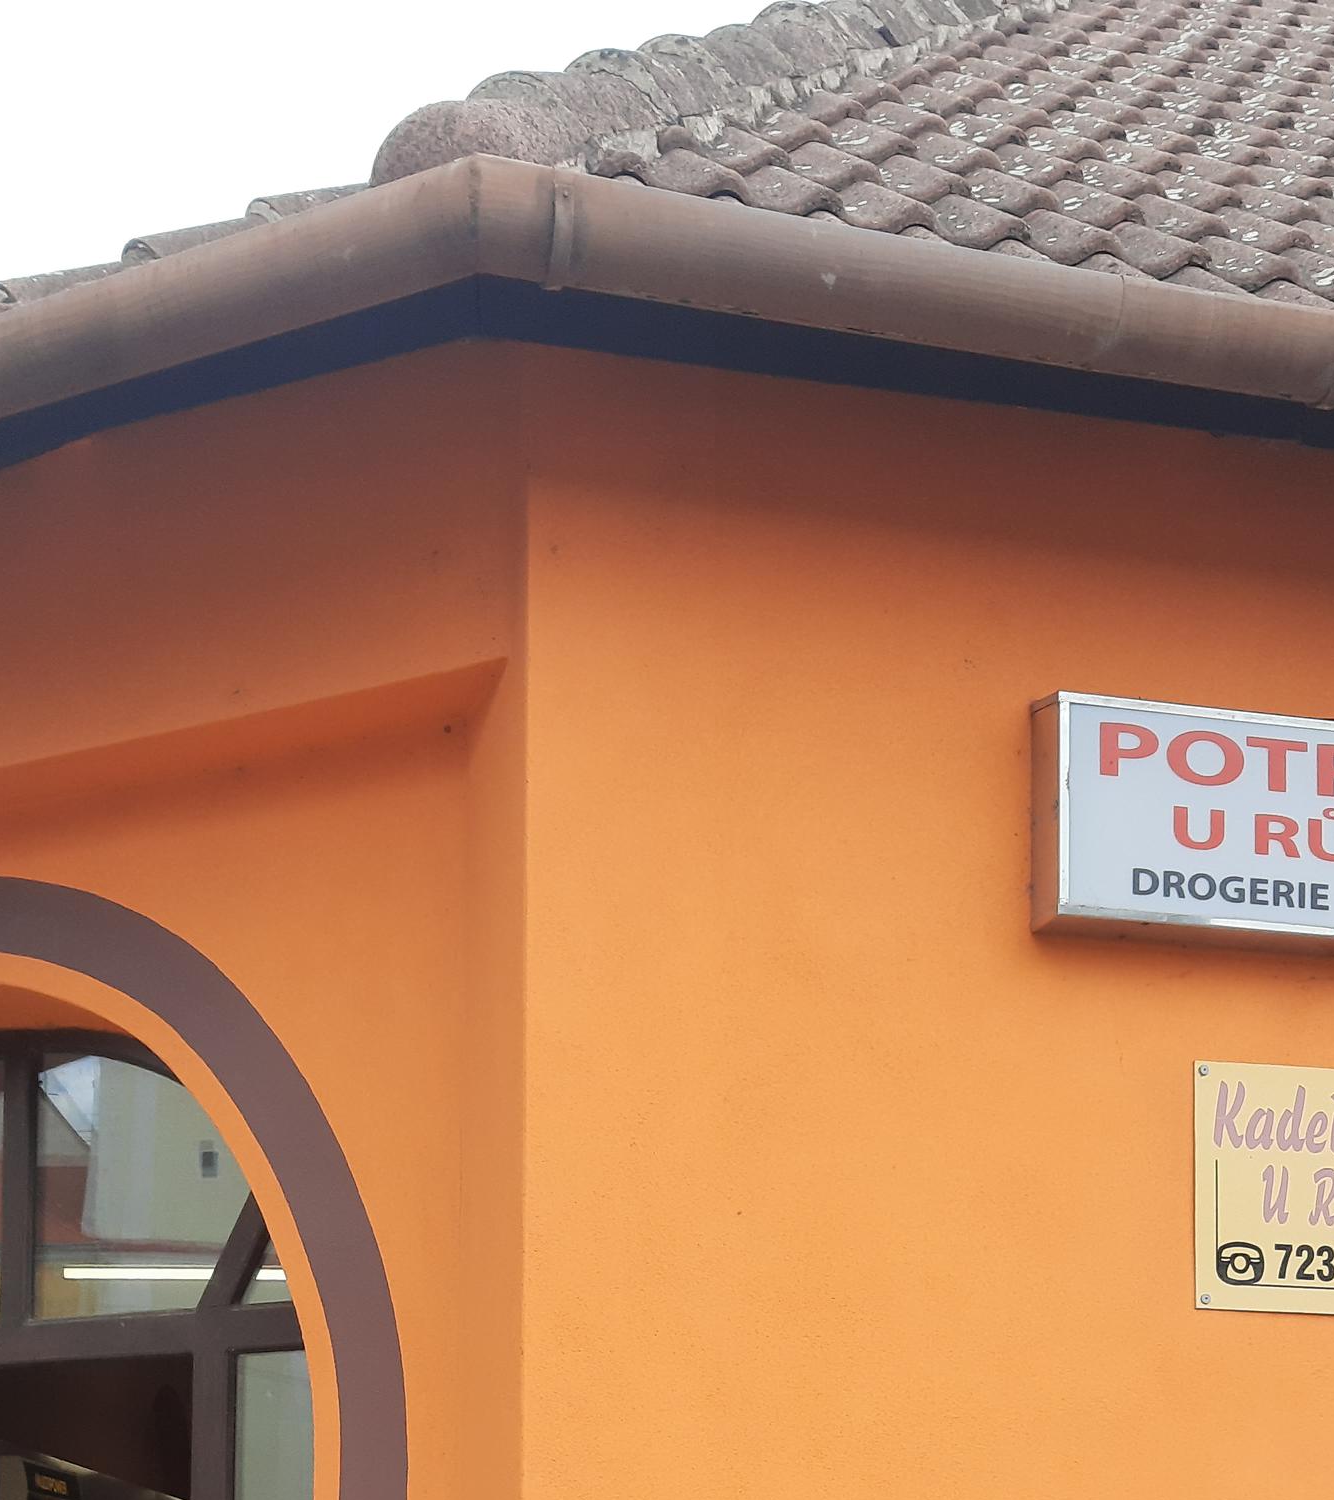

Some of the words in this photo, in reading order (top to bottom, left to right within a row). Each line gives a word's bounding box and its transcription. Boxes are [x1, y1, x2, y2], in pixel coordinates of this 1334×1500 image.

[1173, 805, 1226, 851] U
[1131, 867, 1331, 912] DROGERIE
[1261, 1164, 1289, 1224] U
